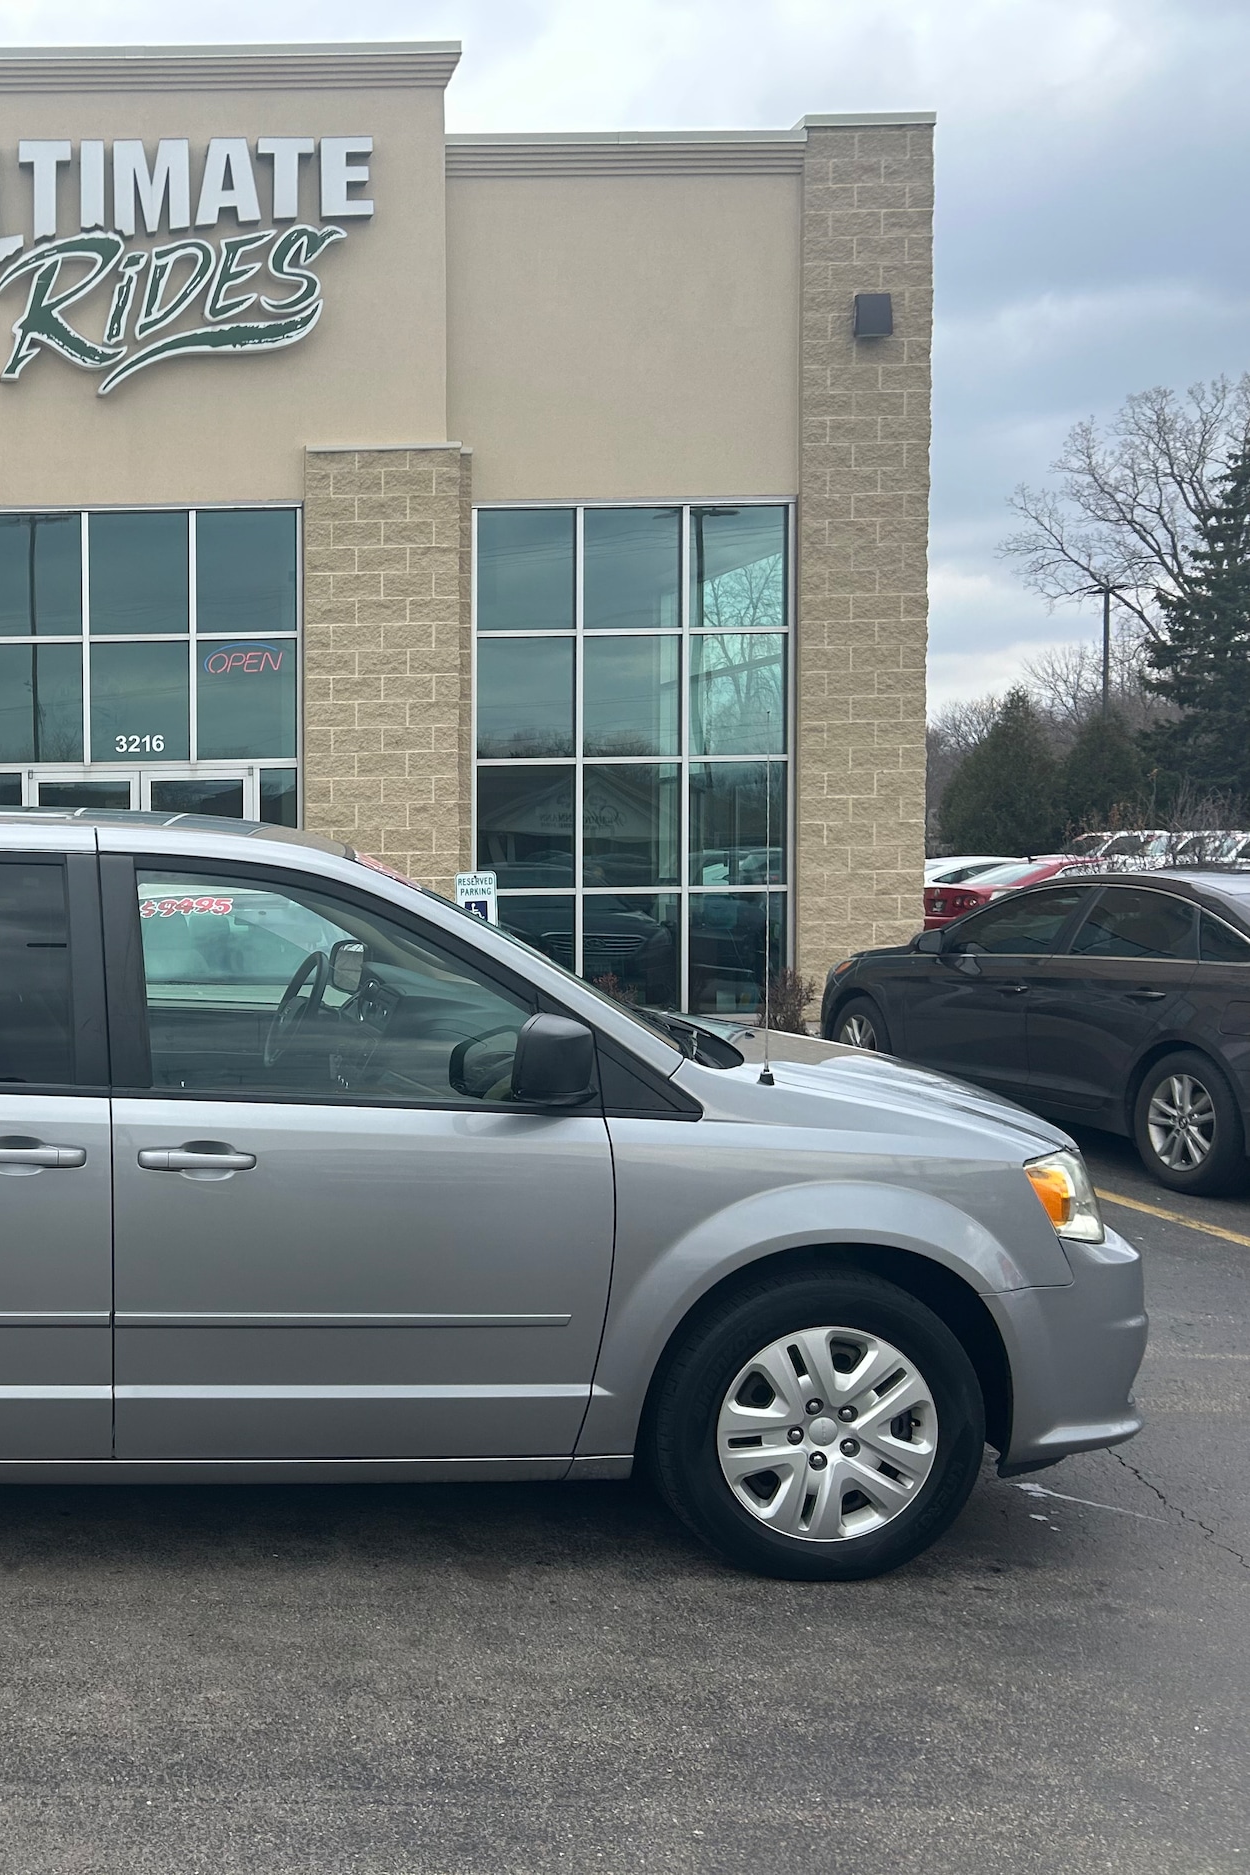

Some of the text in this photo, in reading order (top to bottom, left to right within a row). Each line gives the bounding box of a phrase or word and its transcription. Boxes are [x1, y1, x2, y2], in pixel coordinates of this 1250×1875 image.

[207, 651, 283, 674] OPEN
[114, 734, 165, 753] 3216
[457, 876, 493, 886] RESERVED
[460, 887, 492, 896] PARKING
[139, 896, 234, 919] $9495
